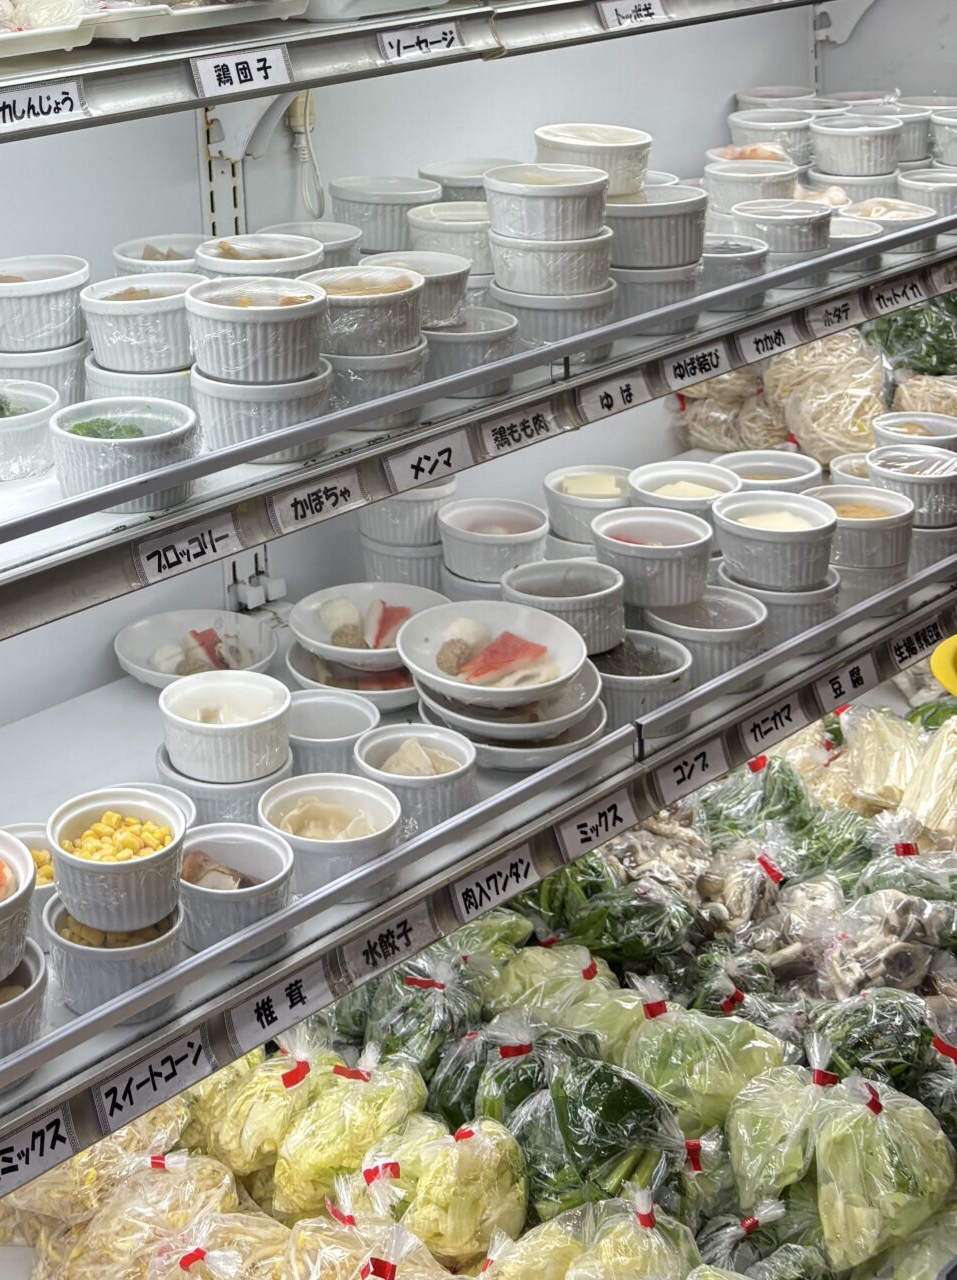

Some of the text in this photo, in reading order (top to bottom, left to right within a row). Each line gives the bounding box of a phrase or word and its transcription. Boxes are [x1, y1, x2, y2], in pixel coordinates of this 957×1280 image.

[388, 29, 456, 58] ソーセージ
[213, 57, 274, 88] 鶏団子
[875, 282, 923, 310] カットイカ
[823, 303, 851, 327] ホタテ
[753, 328, 787, 354] わかめ
[672, 349, 721, 381] ゆば結び
[491, 413, 549, 451] 鶏もも肉
[410, 447, 453, 480] メンマ
[290, 484, 352, 521] かぼちゃ
[146, 529, 230, 573] ブロッコリー
[829, 666, 865, 700] 豆腐
[749, 704, 794, 743] カニカマ
[673, 751, 709, 786] コンブ
[576, 803, 624, 844] ミックス
[460, 857, 532, 914] 肉入ワンタン
[361, 919, 414, 968] 水餃子
[253, 978, 308, 1030] 椎茸
[103, 1040, 203, 1118] スイートコーン
